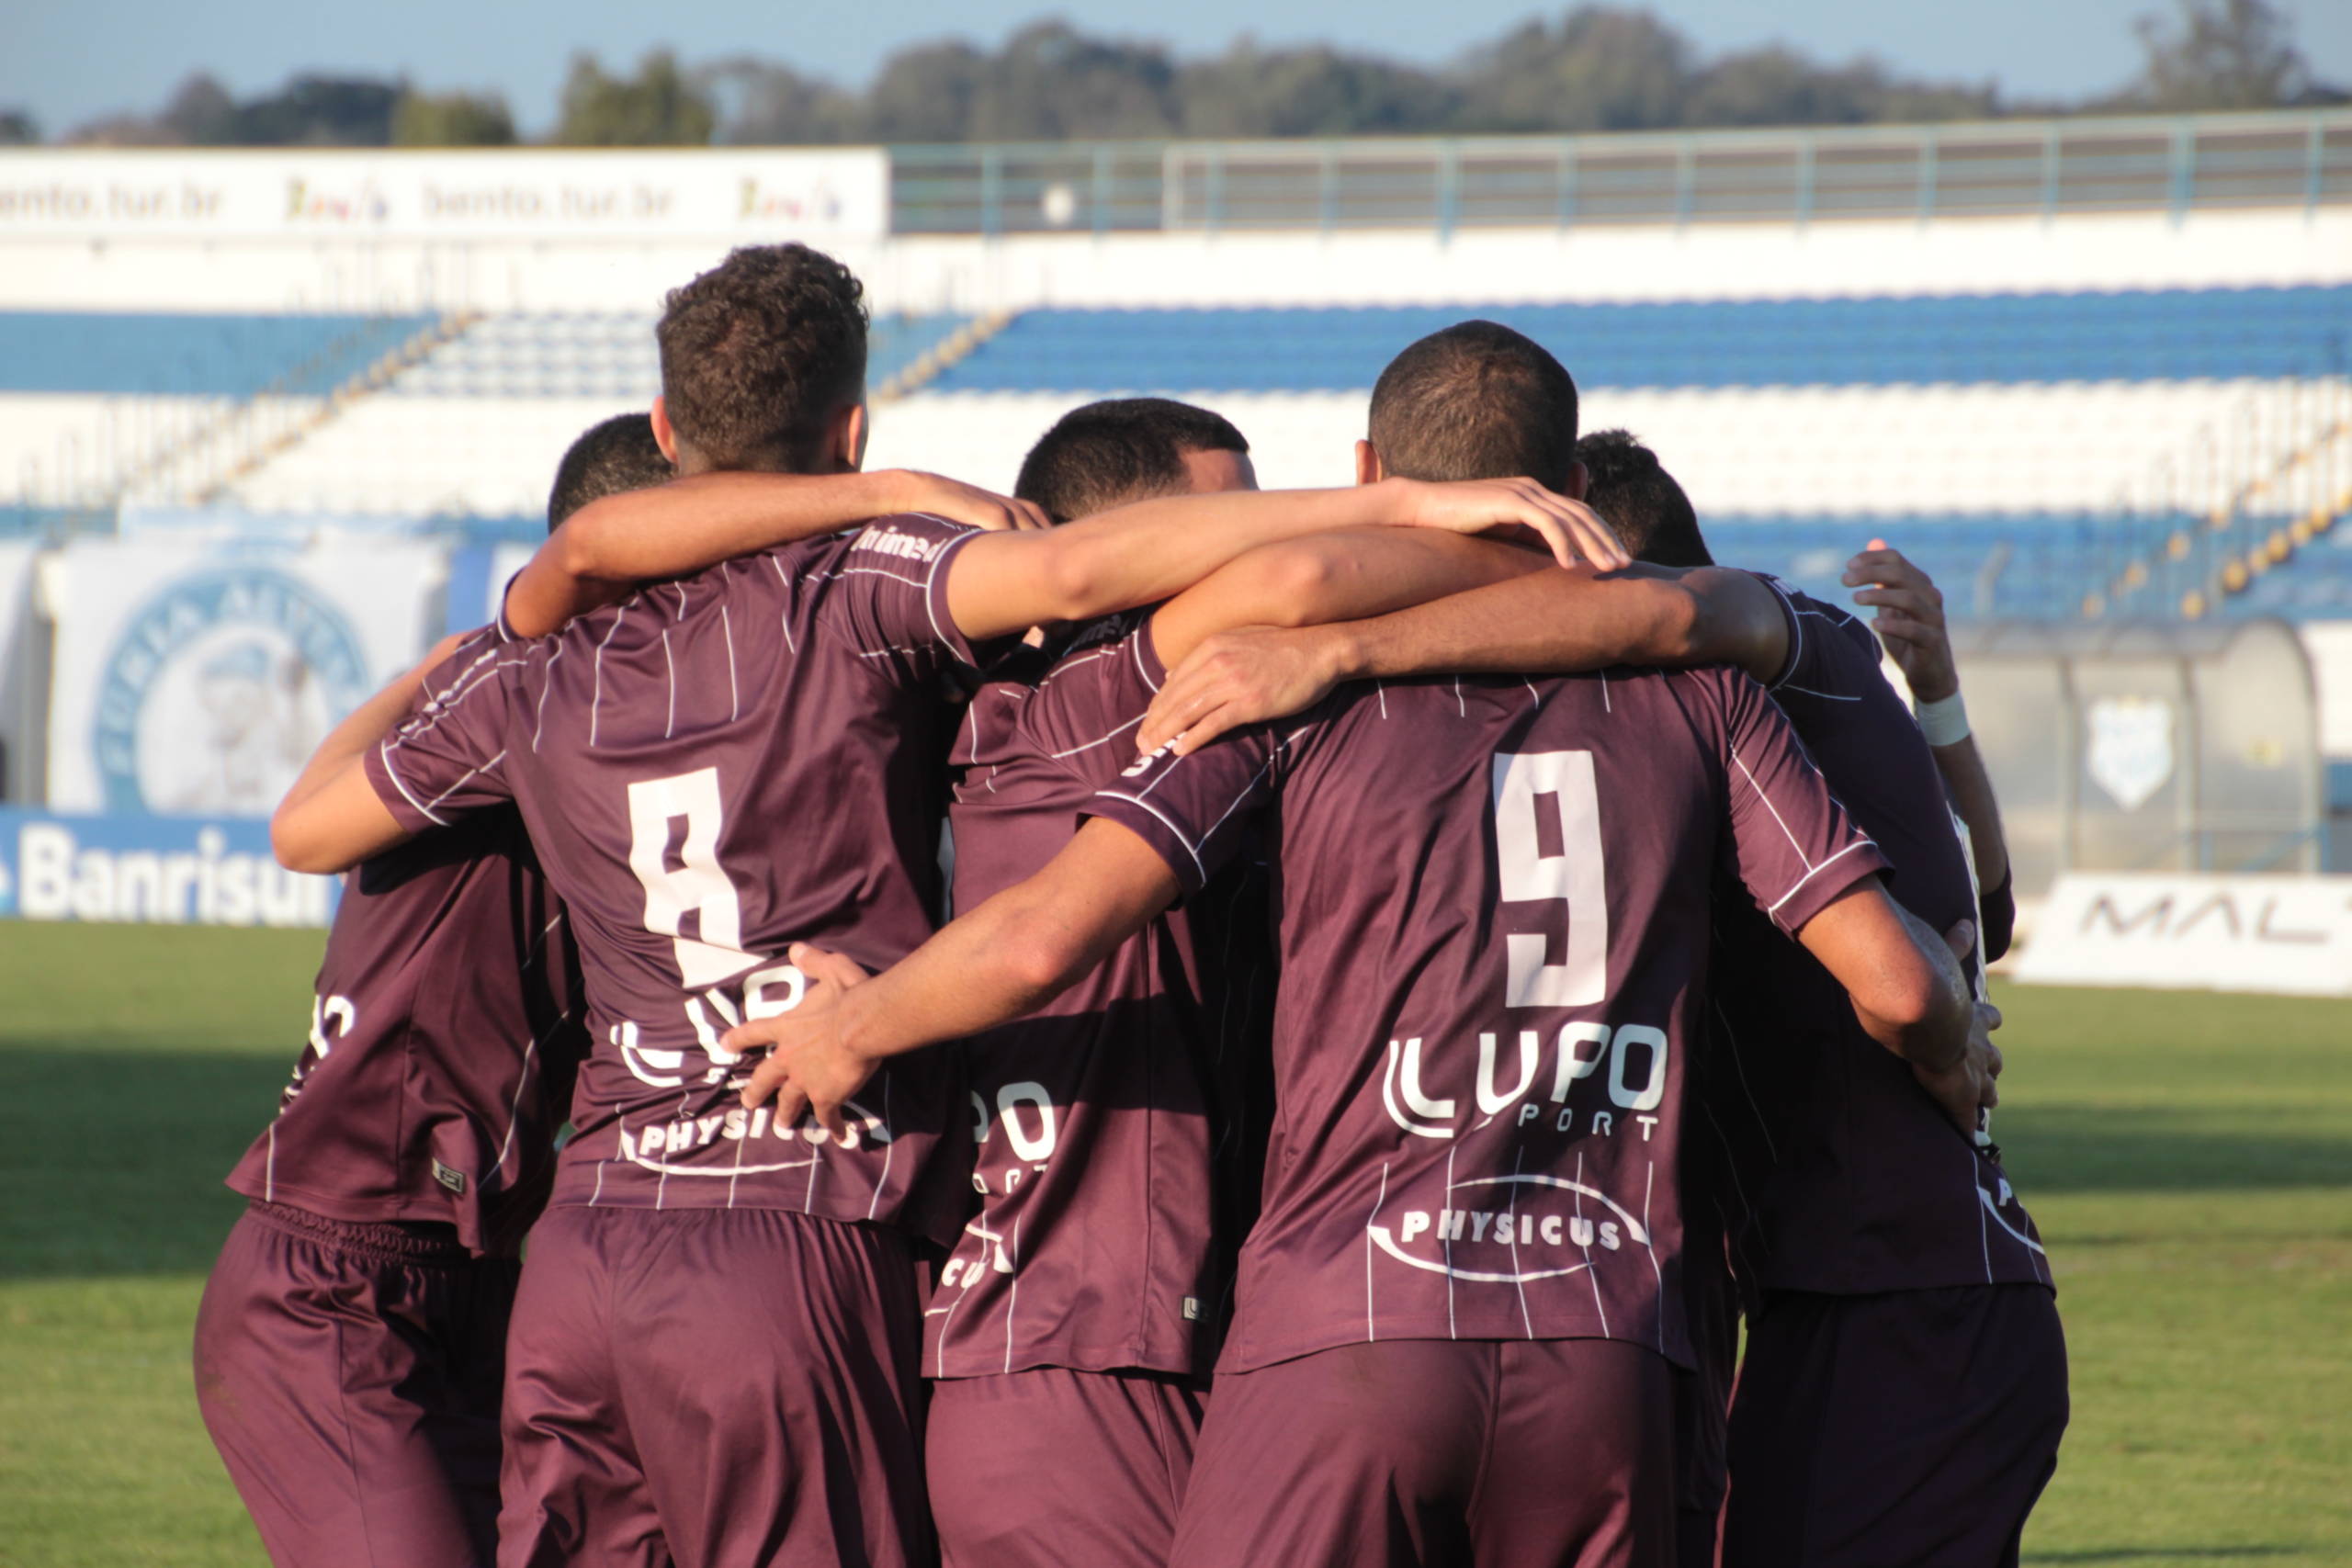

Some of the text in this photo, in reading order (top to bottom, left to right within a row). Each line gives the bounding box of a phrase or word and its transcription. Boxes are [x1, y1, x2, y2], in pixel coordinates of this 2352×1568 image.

[0, 183, 223, 222] ento.tur.br
[18, 825, 329, 928] Banrisul
[628, 766, 770, 989] 8
[1494, 750, 1608, 1008] 9
[2078, 889, 2352, 944] MAL
[610, 965, 807, 1088] LUP
[1384, 1021, 1668, 1138] LUPO
[1473, 1103, 1658, 1141] PORT
[1401, 1209, 1620, 1251] PHYSICUS
